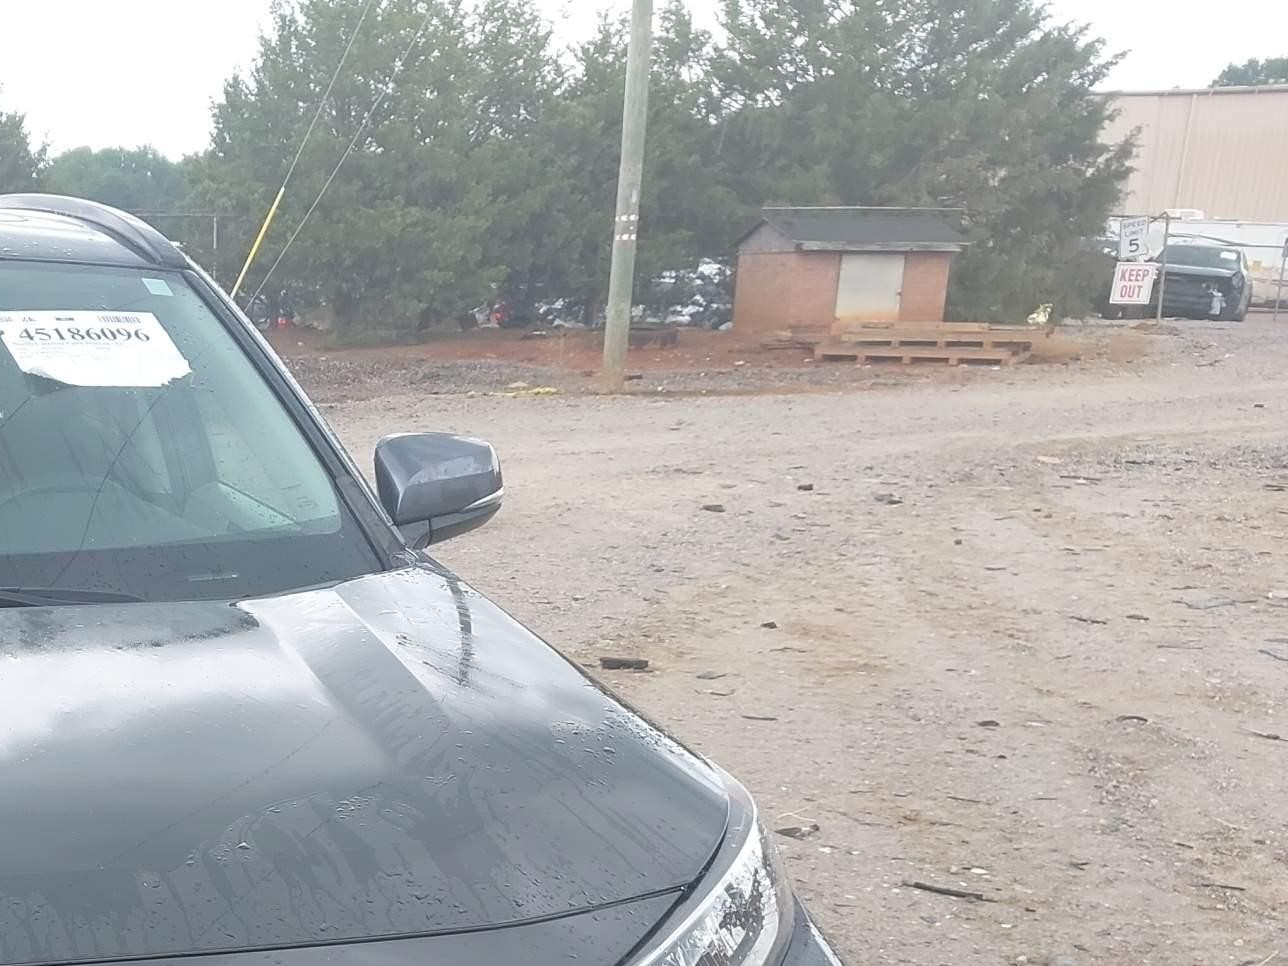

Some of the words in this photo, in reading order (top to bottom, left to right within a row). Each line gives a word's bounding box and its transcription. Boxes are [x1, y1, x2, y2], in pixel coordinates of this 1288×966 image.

[1128, 238, 1140, 254] 5
[1119, 268, 1150, 282] KEEP
[1119, 284, 1144, 299] OUT
[18, 327, 150, 342] 45186096
